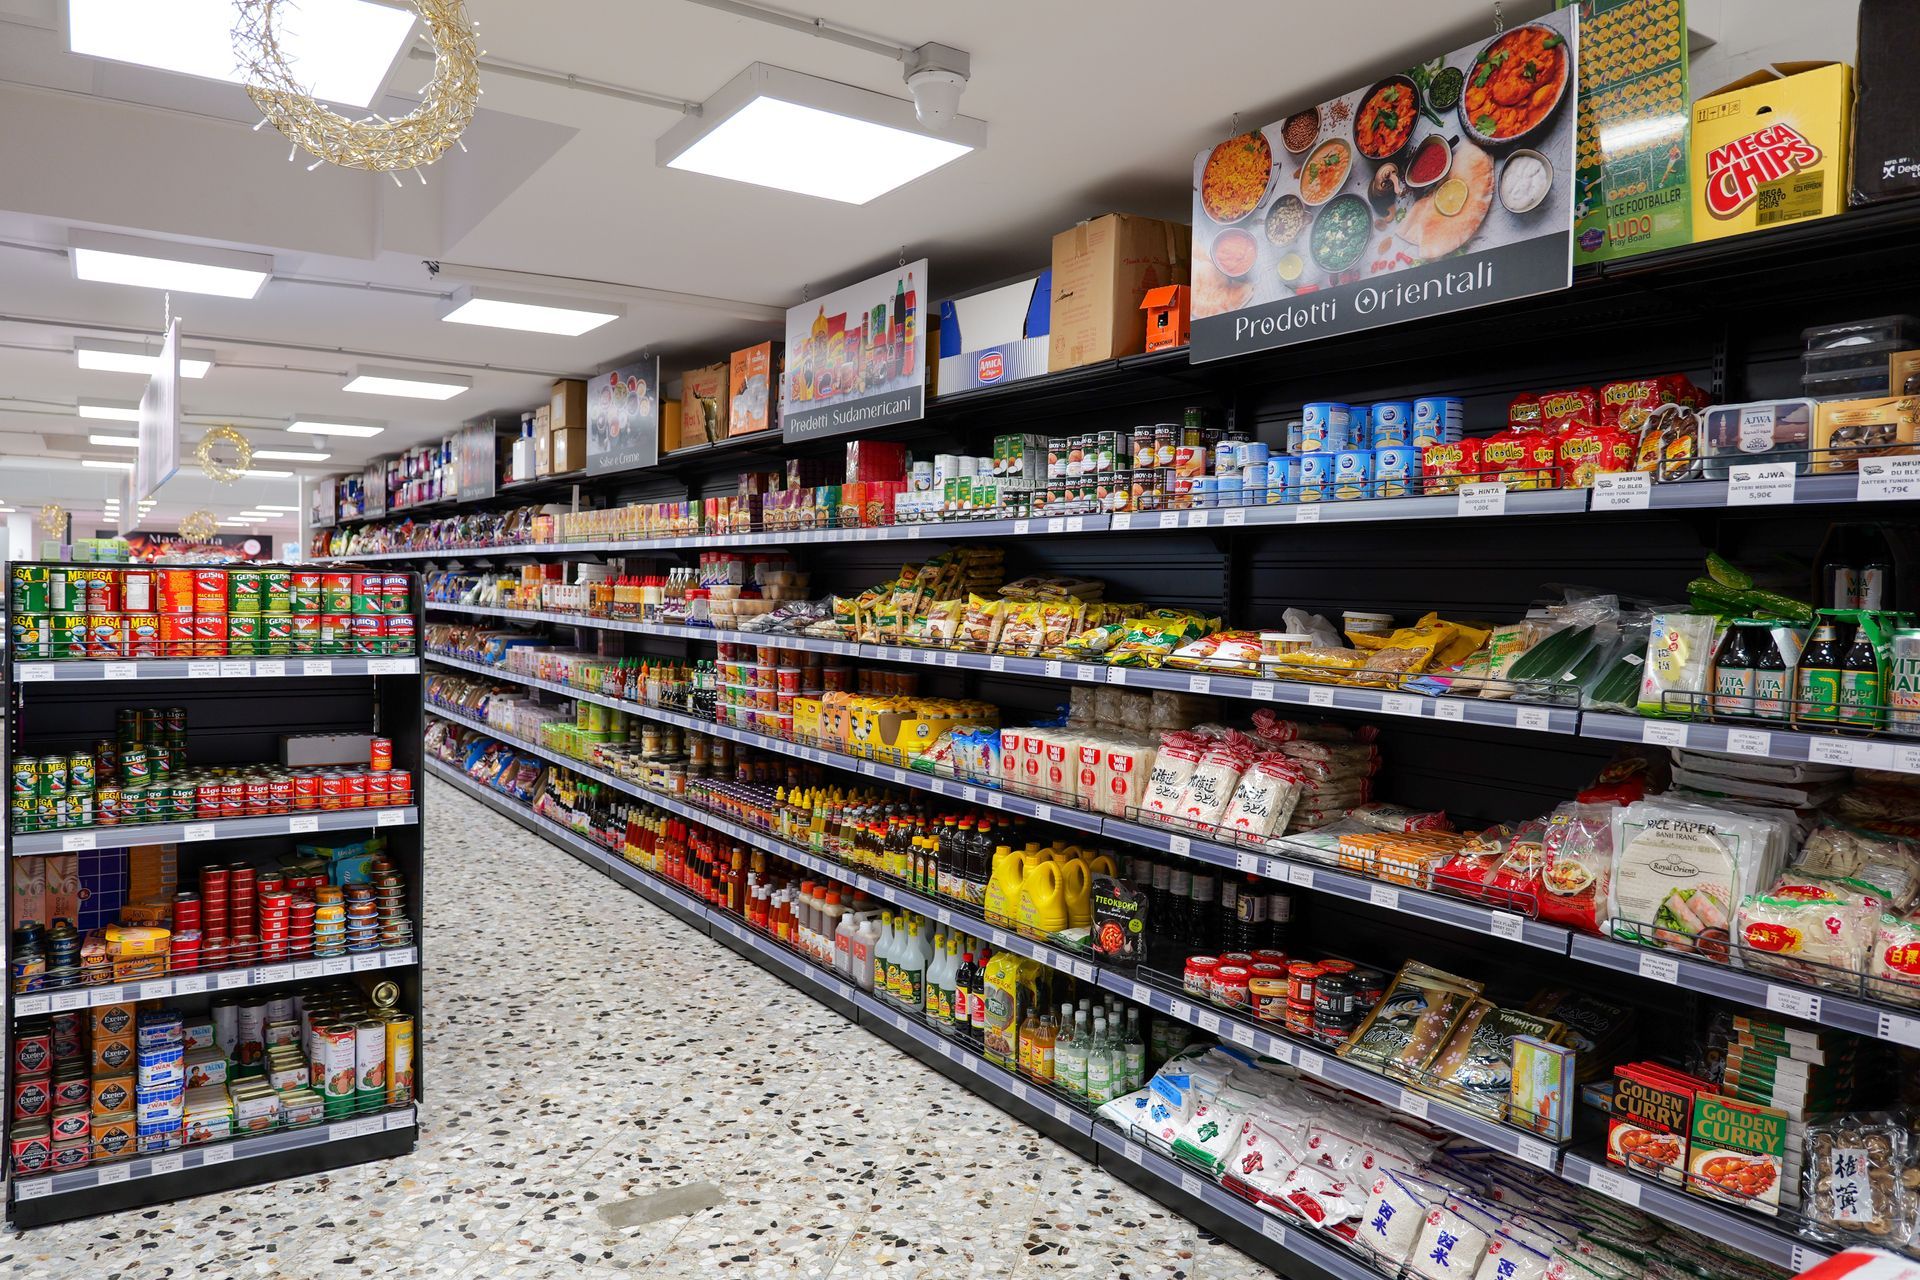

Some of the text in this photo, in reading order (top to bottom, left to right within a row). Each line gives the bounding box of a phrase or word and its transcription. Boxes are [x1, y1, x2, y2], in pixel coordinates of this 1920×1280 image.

[1708, 124, 1797, 171] MEGA
[1706, 142, 1815, 213] CHIPS
[1758, 193, 1786, 204] POTATO
[1759, 187, 1783, 198] MEGA
[1605, 187, 1681, 219] DICE FOOTBALLER
[1758, 200, 1780, 211] CHIPS
[1607, 214, 1652, 242] LUDO
[1235, 261, 1493, 341] Prodotti Orientali
[979, 357, 1002, 373] AMICA
[1606, 386, 1650, 406] Noodles
[832, 396, 911, 426] Sudamericani
[1545, 396, 1583, 418] Noodles
[1744, 416, 1772, 425] AJWA
[1485, 444, 1523, 462] Noodles
[1561, 437, 1602, 460] Noodles
[1426, 446, 1461, 465] Noodles
[1758, 472, 1785, 480] AJWA
[1749, 491, 1772, 499] 5,90€
[1883, 486, 1908, 494] 1,79€
[12, 568, 33, 582] EGA
[13, 616, 35, 629] EGA
[90, 616, 121, 629] MEGA
[131, 617, 159, 630] MEGA
[1719, 677, 1744, 688] VITA
[1756, 679, 1780, 690] VITA
[1716, 687, 1745, 697] MALT
[1800, 684, 1826, 697] yper
[70, 759, 92, 768] MEGA
[125, 754, 146, 764] Ligo
[13, 764, 37, 774] MEGA
[172, 789, 194, 797] Ligo
[1647, 819, 1717, 837] RICE PAPER
[1656, 832, 1698, 842] BANH TRANG
[1340, 844, 1375, 864] TOFU
[1380, 857, 1420, 880] TOFU
[1653, 862, 1696, 875] Royal Orient
[1095, 895, 1138, 912] TTEOKBOKKI
[104, 1014, 129, 1024] Exeter
[1500, 1013, 1544, 1033] YUMMYTO
[21, 1051, 46, 1061] Exeter
[104, 1049, 129, 1058] Exeter
[151, 1063, 171, 1072] ZWAN
[20, 1094, 45, 1104] Exeter
[101, 1090, 126, 1100] Exeter
[1618, 1079, 1682, 1113] GOLDEN
[147, 1101, 168, 1110] ZWAN
[1614, 1093, 1685, 1129] CURRY
[1702, 1103, 1778, 1135] GOLDEN
[1697, 1119, 1781, 1153] CURRY
